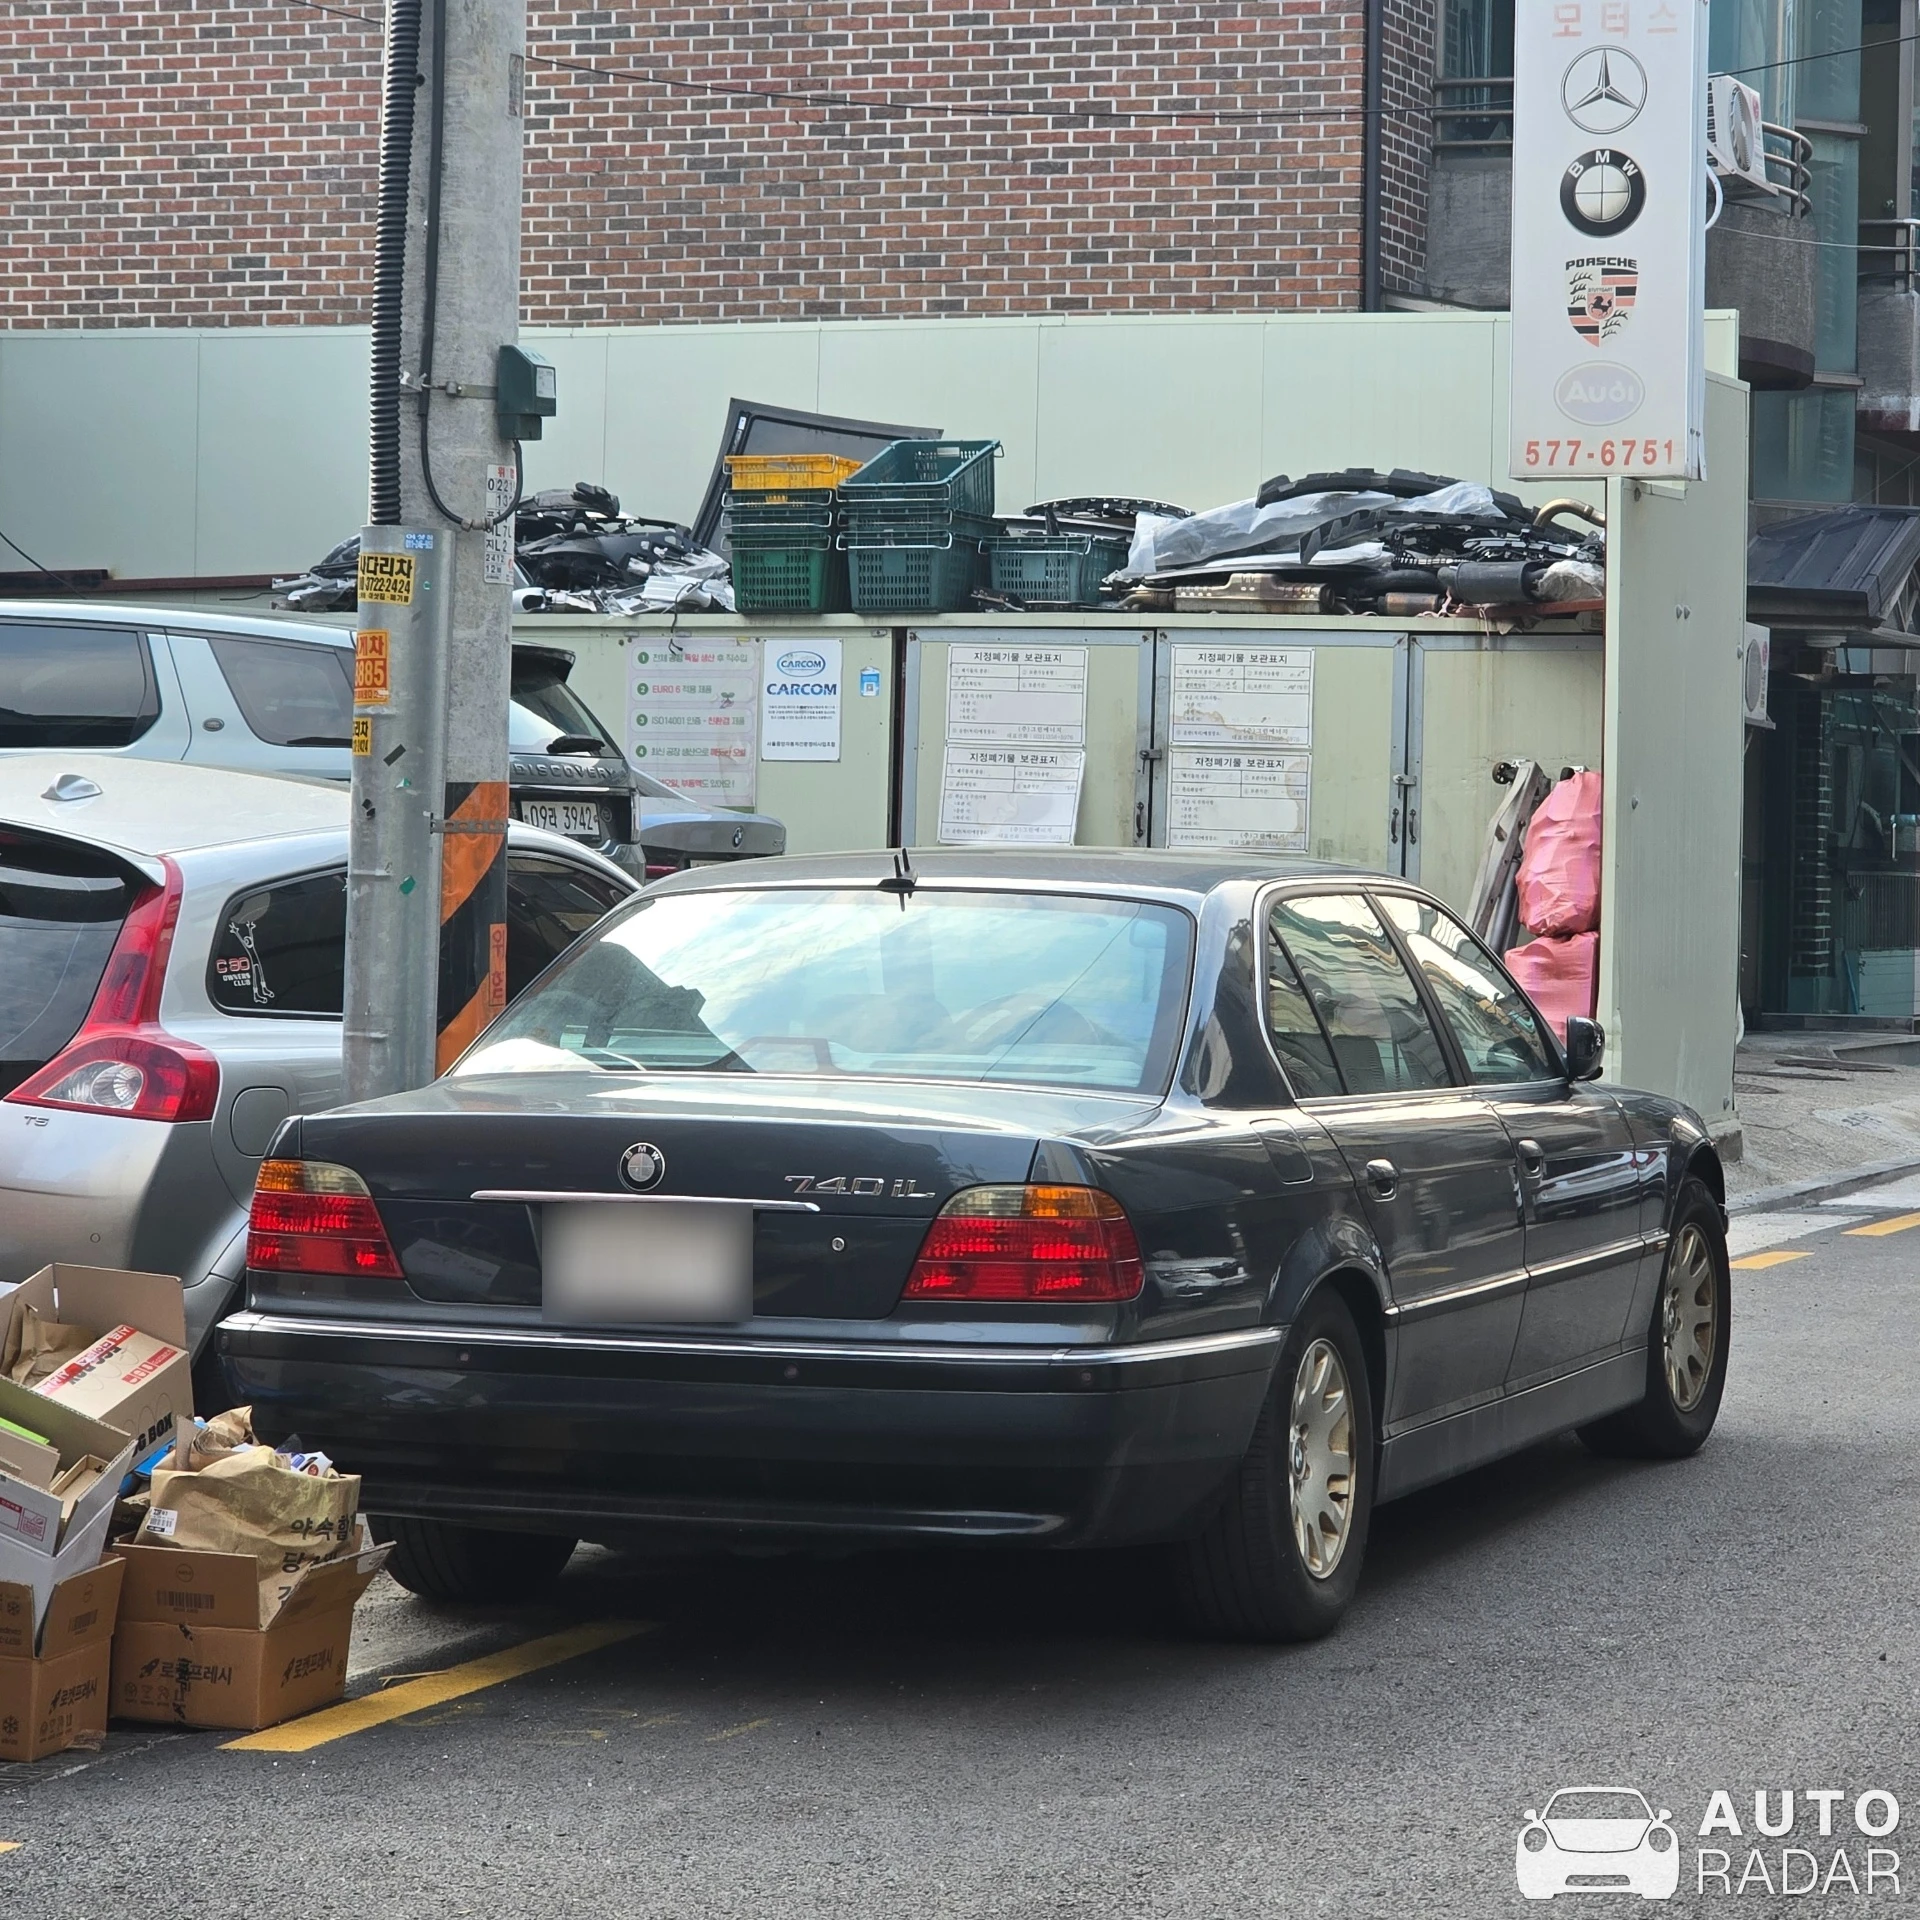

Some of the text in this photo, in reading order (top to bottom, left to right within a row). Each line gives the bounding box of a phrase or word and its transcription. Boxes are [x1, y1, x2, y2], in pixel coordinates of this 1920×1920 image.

[1567, 149, 1640, 179] BMW
[1565, 256, 1638, 271] PORSCHE
[1563, 379, 1636, 403] Audi
[1524, 440, 1674, 467] 577-6751
[356, 635, 384, 656] 게차
[780, 659, 821, 669] CARCOM
[974, 652, 1062, 663] 지정폐기물 보관표지
[1198, 653, 1288, 664] 지정폐기물 보관표지
[652, 684, 674, 694] EURO
[766, 683, 837, 696] CARCOM
[651, 716, 685, 725] ISO14001
[970, 752, 1058, 765] 지정폐기물 보관표지
[1195, 757, 1285, 769] 지정폐기물 보관표지
[514, 763, 614, 779] DISCOVERY
[530, 805, 593, 830] 09라 3942
[625, 1145, 661, 1161] BMW
[147, 1412, 173, 1445] BOX
[293, 1646, 335, 1680] 로켓프레시
